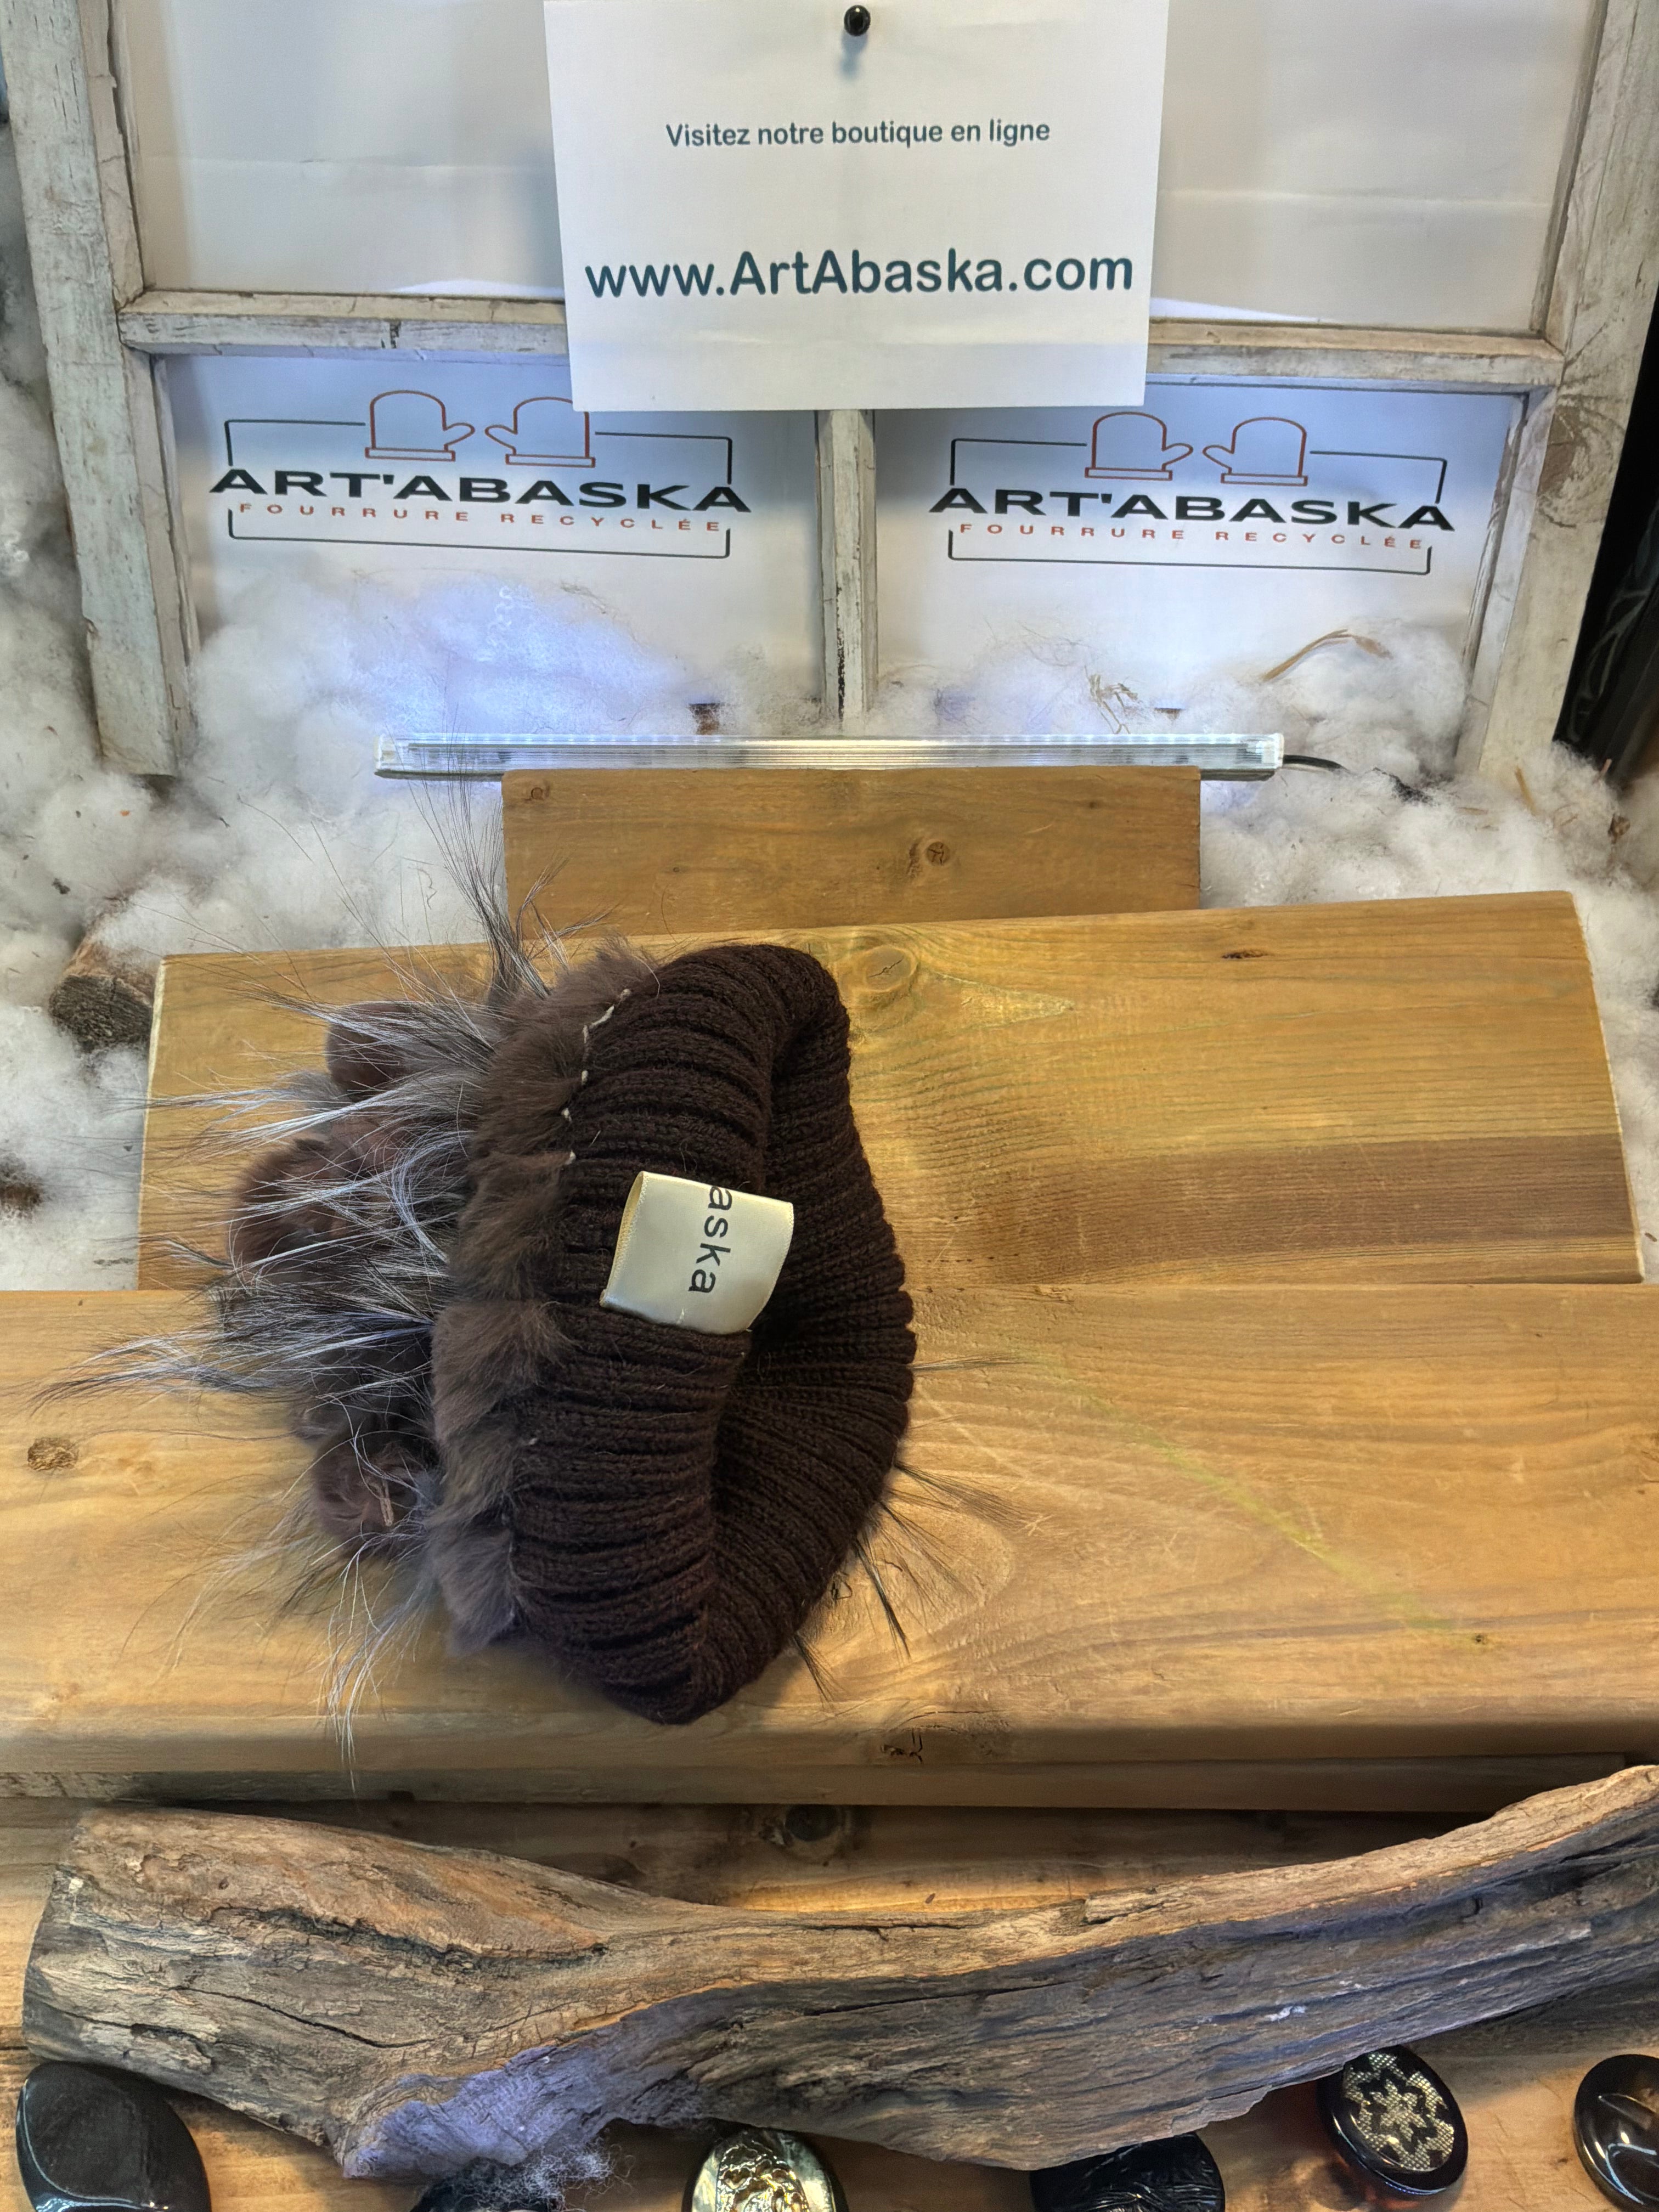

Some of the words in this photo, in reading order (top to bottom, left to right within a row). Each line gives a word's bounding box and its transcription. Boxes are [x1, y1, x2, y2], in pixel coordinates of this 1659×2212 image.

[665, 123, 751, 148] Visitez
[757, 122, 825, 145] notre
[831, 120, 944, 148] boutique
[950, 123, 982, 143] en
[989, 119, 1051, 146] ligne
[585, 248, 1133, 298] www.ArtAbaska.com
[208, 467, 752, 514] ART'ABASKA
[239, 502, 470, 523] FOURRURE
[500, 513, 720, 532] RECYCLÉE
[928, 487, 1455, 532] ART'ABASKA
[960, 522, 1185, 541] FOURRURE
[1215, 531, 1423, 550] RECYCLÉE
